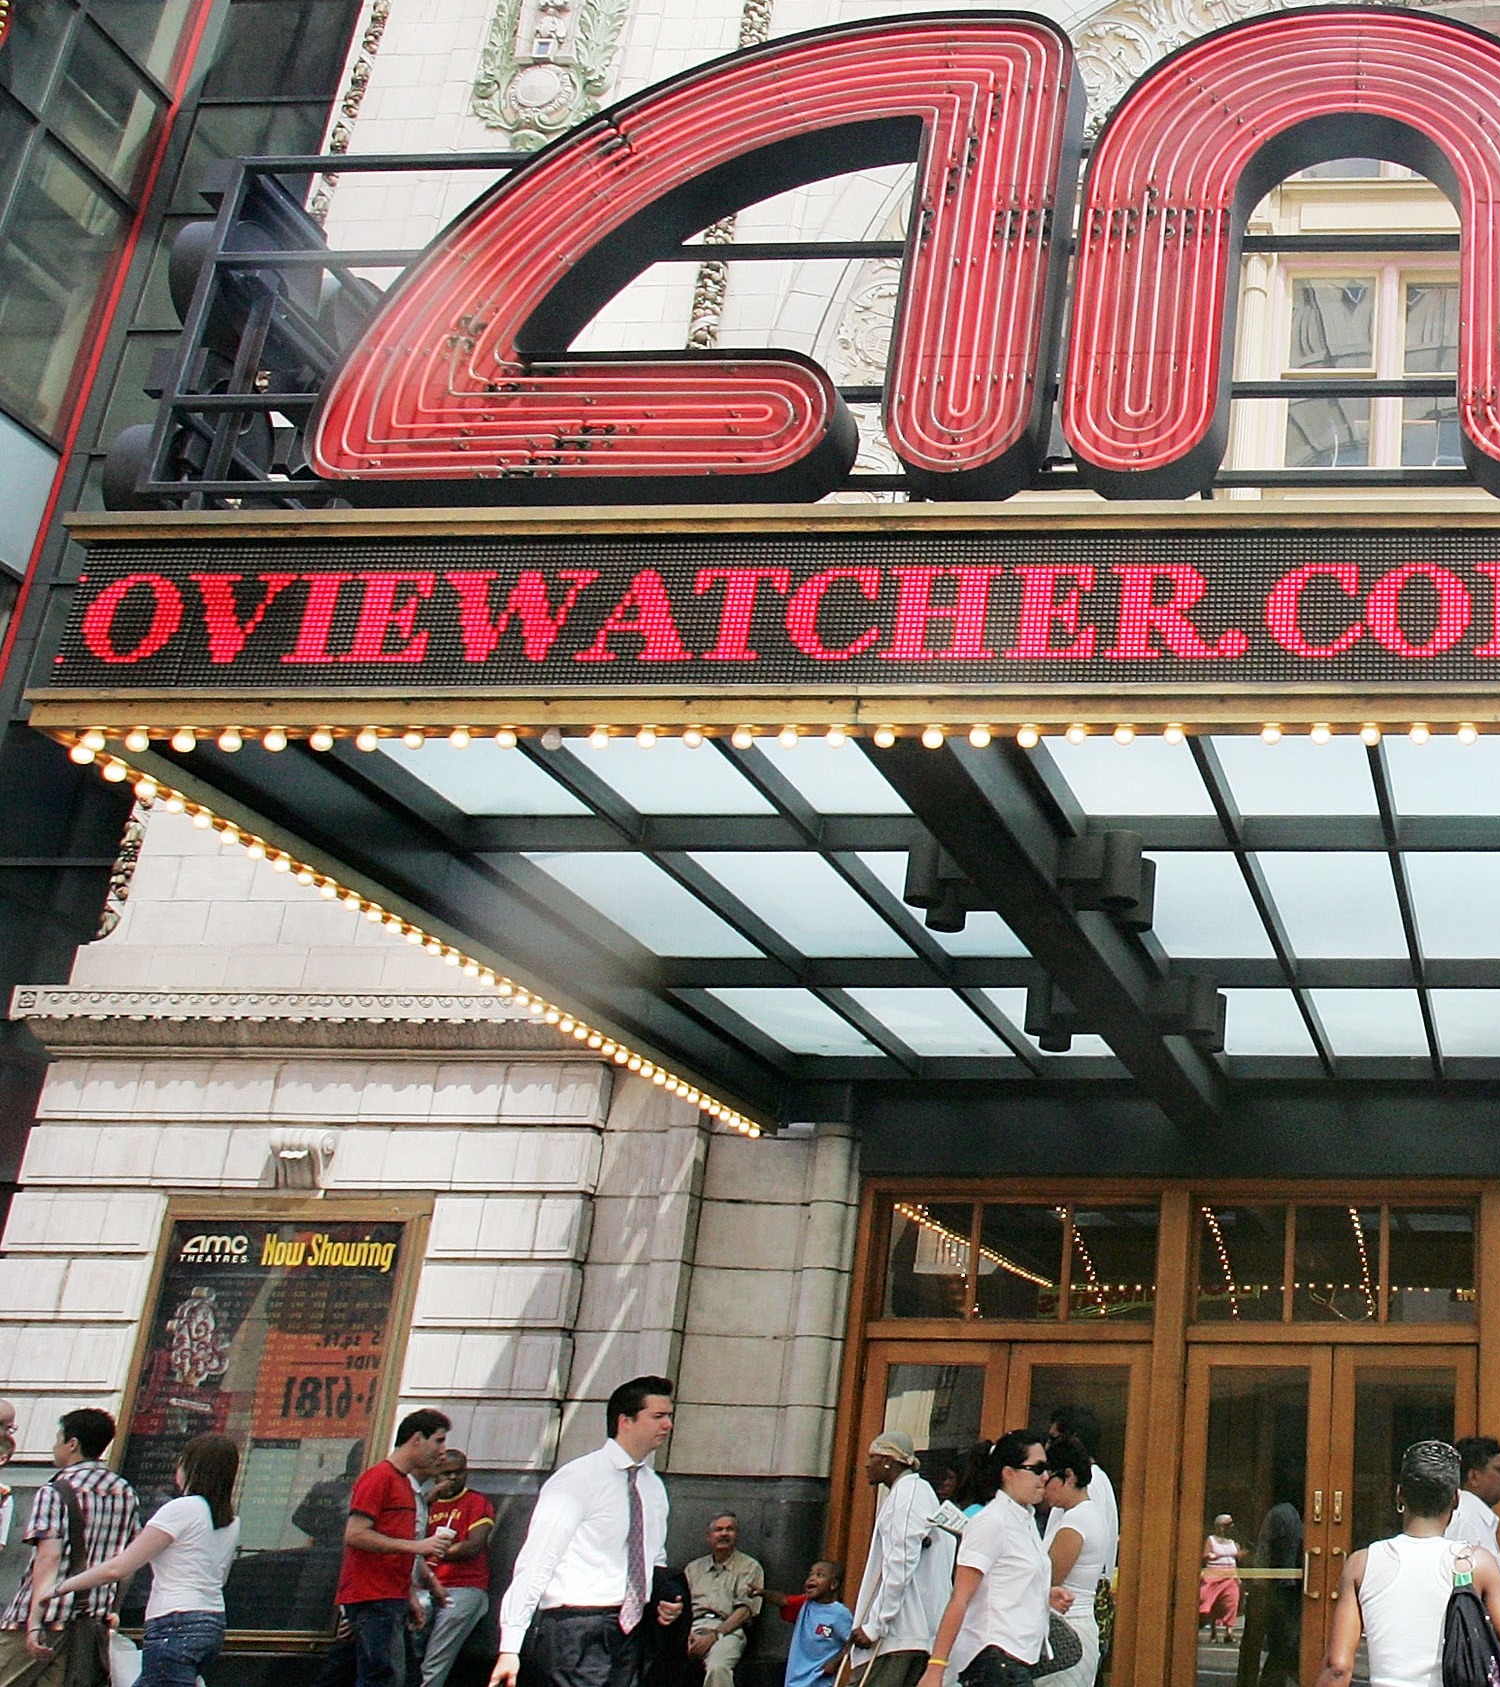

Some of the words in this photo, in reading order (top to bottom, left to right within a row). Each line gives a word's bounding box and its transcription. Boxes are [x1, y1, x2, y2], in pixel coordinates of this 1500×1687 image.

[179, 1254, 249, 1264] THEATRES
[261, 1233, 305, 1266] Now
[308, 1233, 396, 1272] Showing
